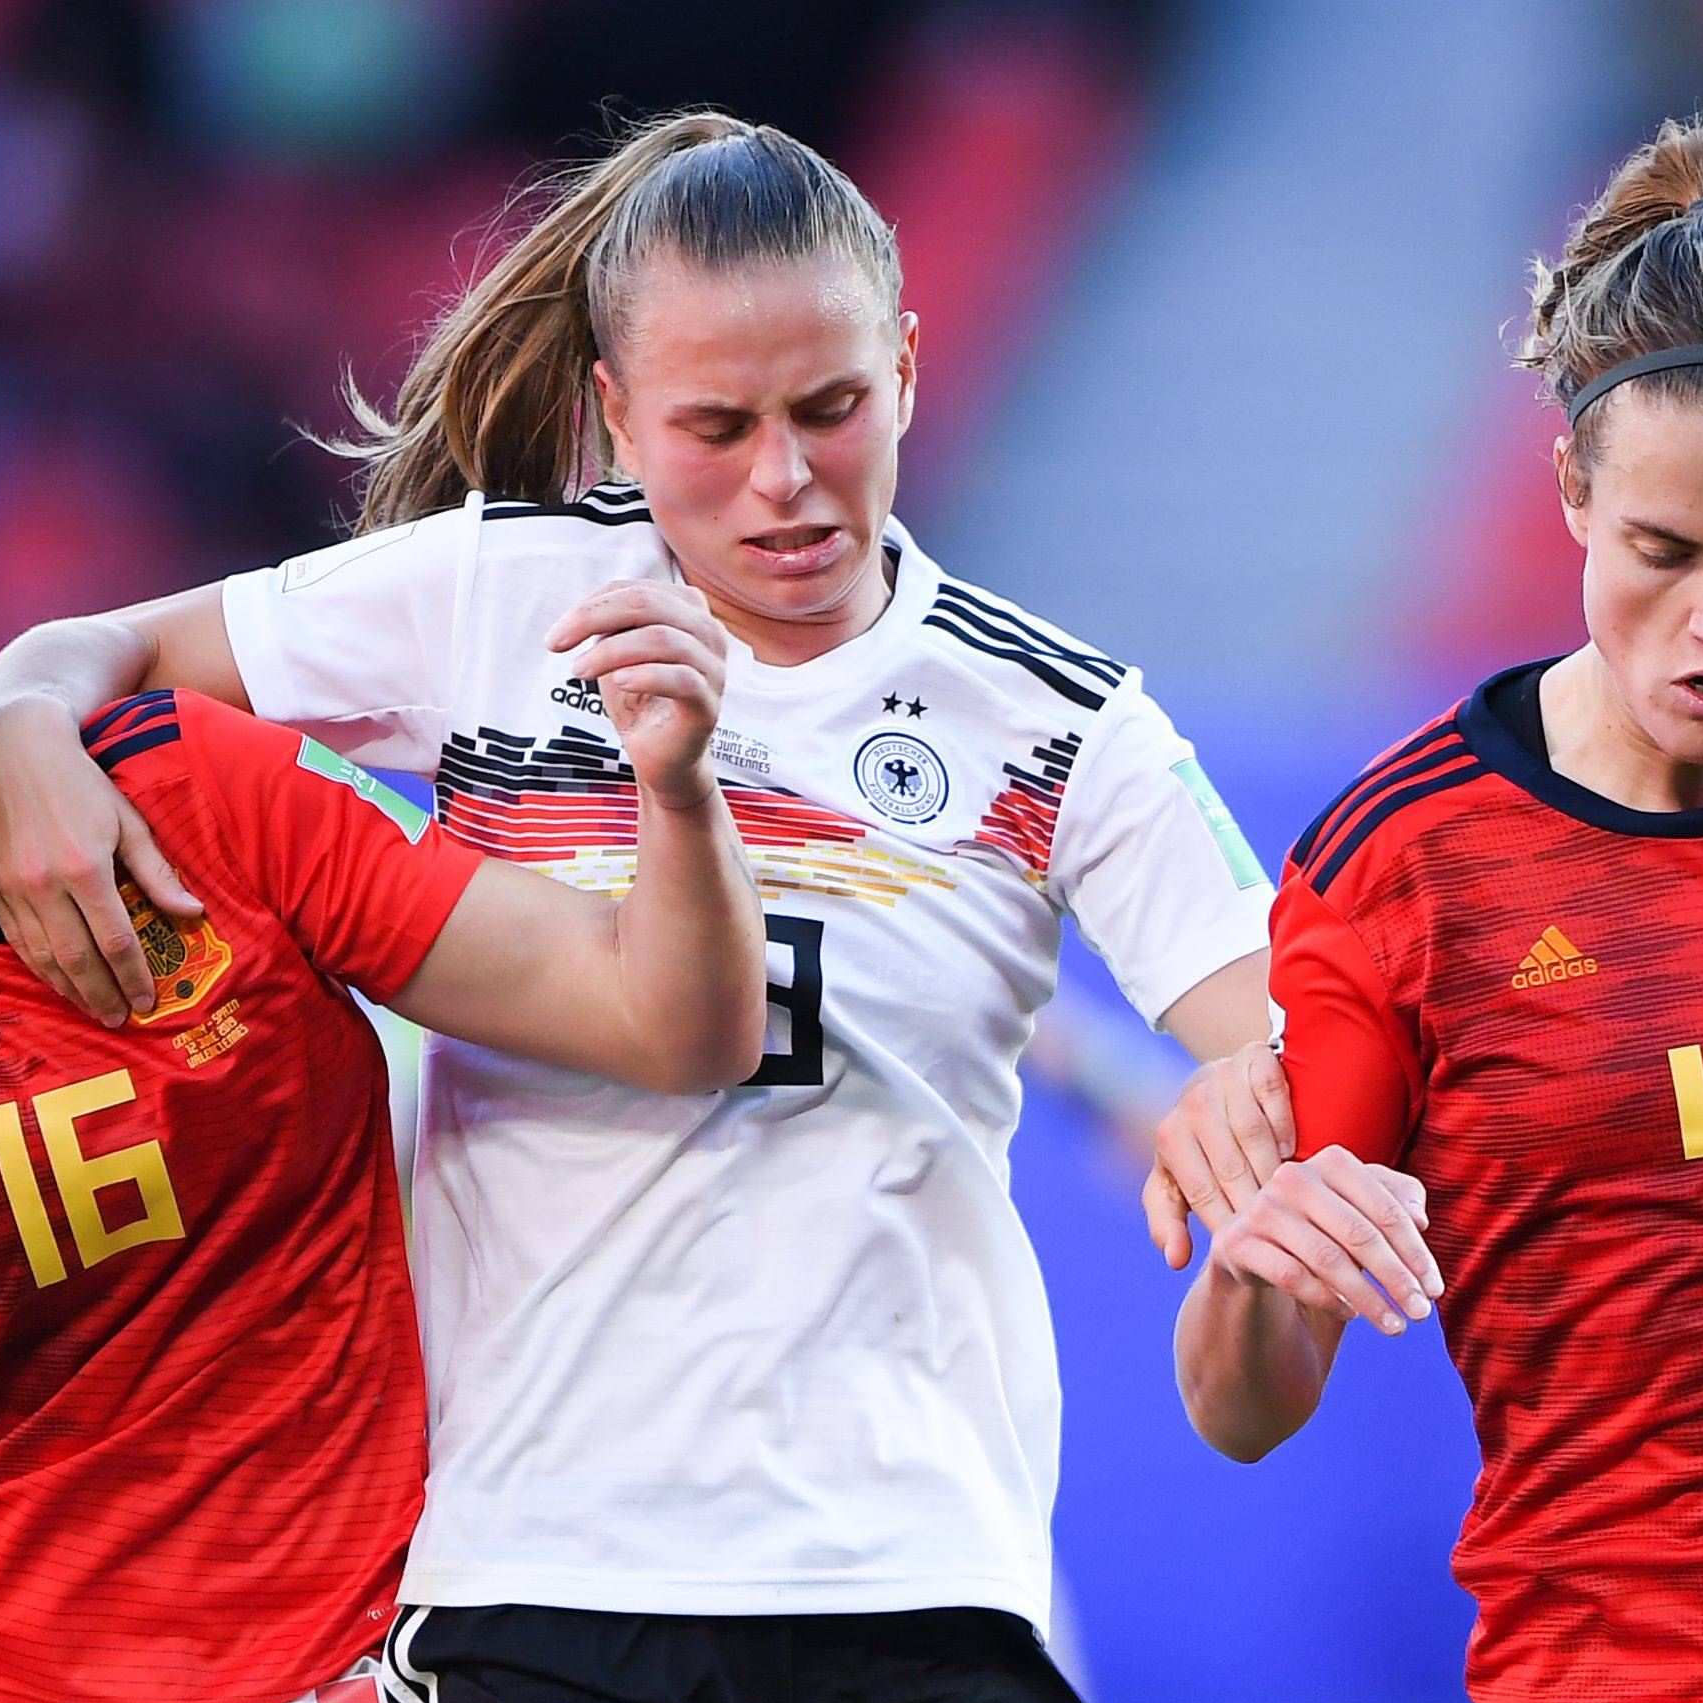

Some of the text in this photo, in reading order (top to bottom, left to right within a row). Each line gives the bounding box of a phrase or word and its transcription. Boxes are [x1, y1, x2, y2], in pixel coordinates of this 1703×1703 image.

[550, 688, 610, 718] adid
[717, 740, 742, 755] JUNI
[745, 746, 769, 761] 2019
[873, 744, 928, 765] DEUTSCHER
[1511, 957, 1598, 990] adidas
